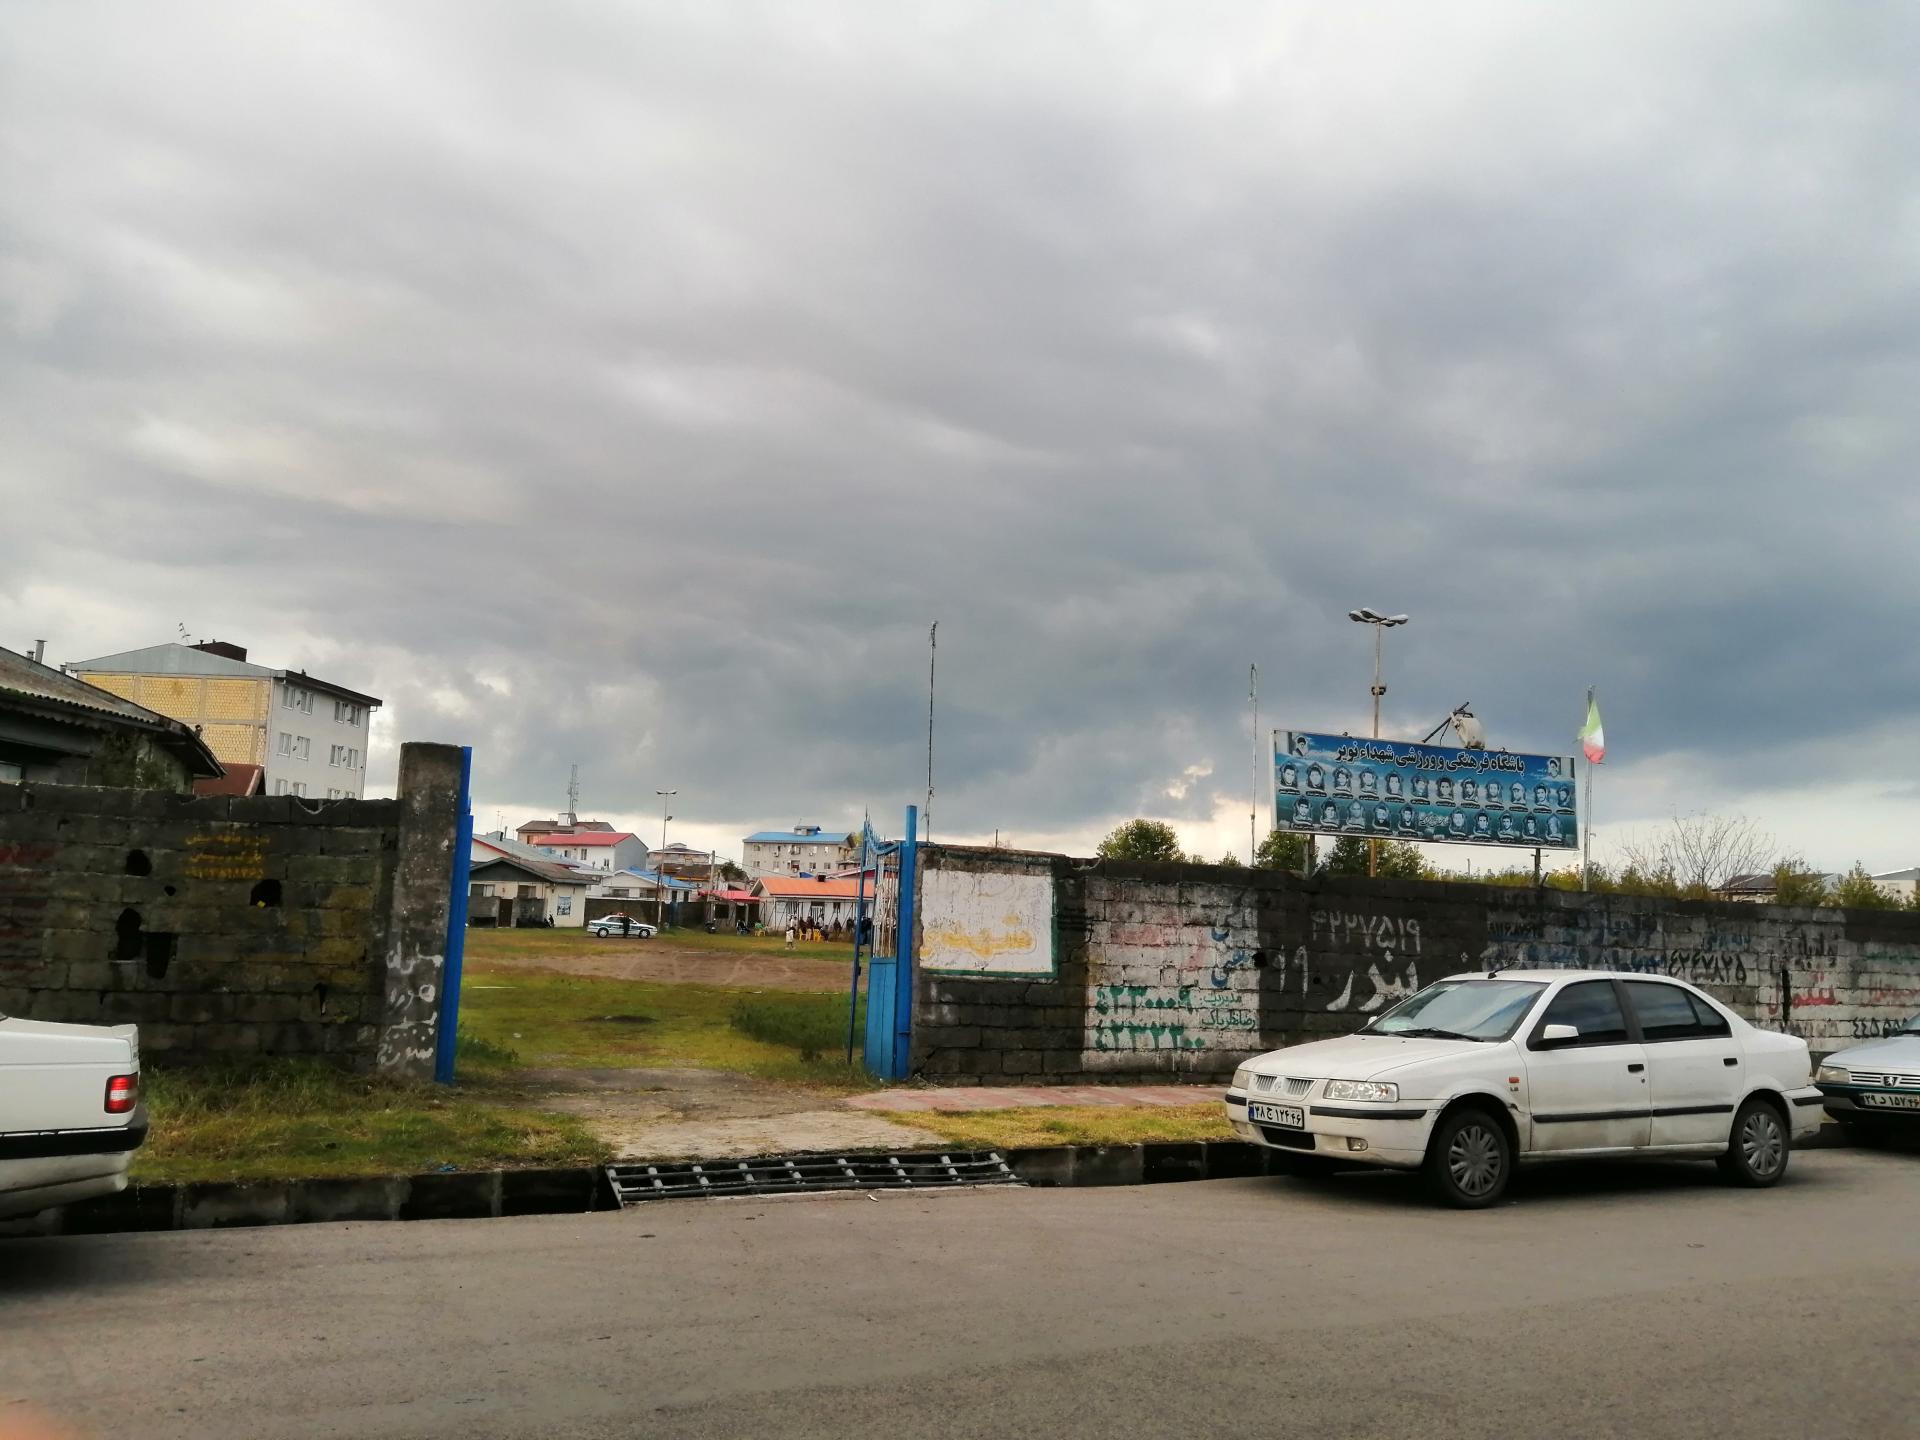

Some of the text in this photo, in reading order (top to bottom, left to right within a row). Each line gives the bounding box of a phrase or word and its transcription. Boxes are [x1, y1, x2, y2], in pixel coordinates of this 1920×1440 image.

[1359, 741, 1395, 765] شهداء
[1395, 746, 1436, 771] ورزشی
[1437, 755, 1445, 770] و
[1446, 751, 1489, 774] فرهنگی
[1491, 753, 1525, 777] باشگاه
